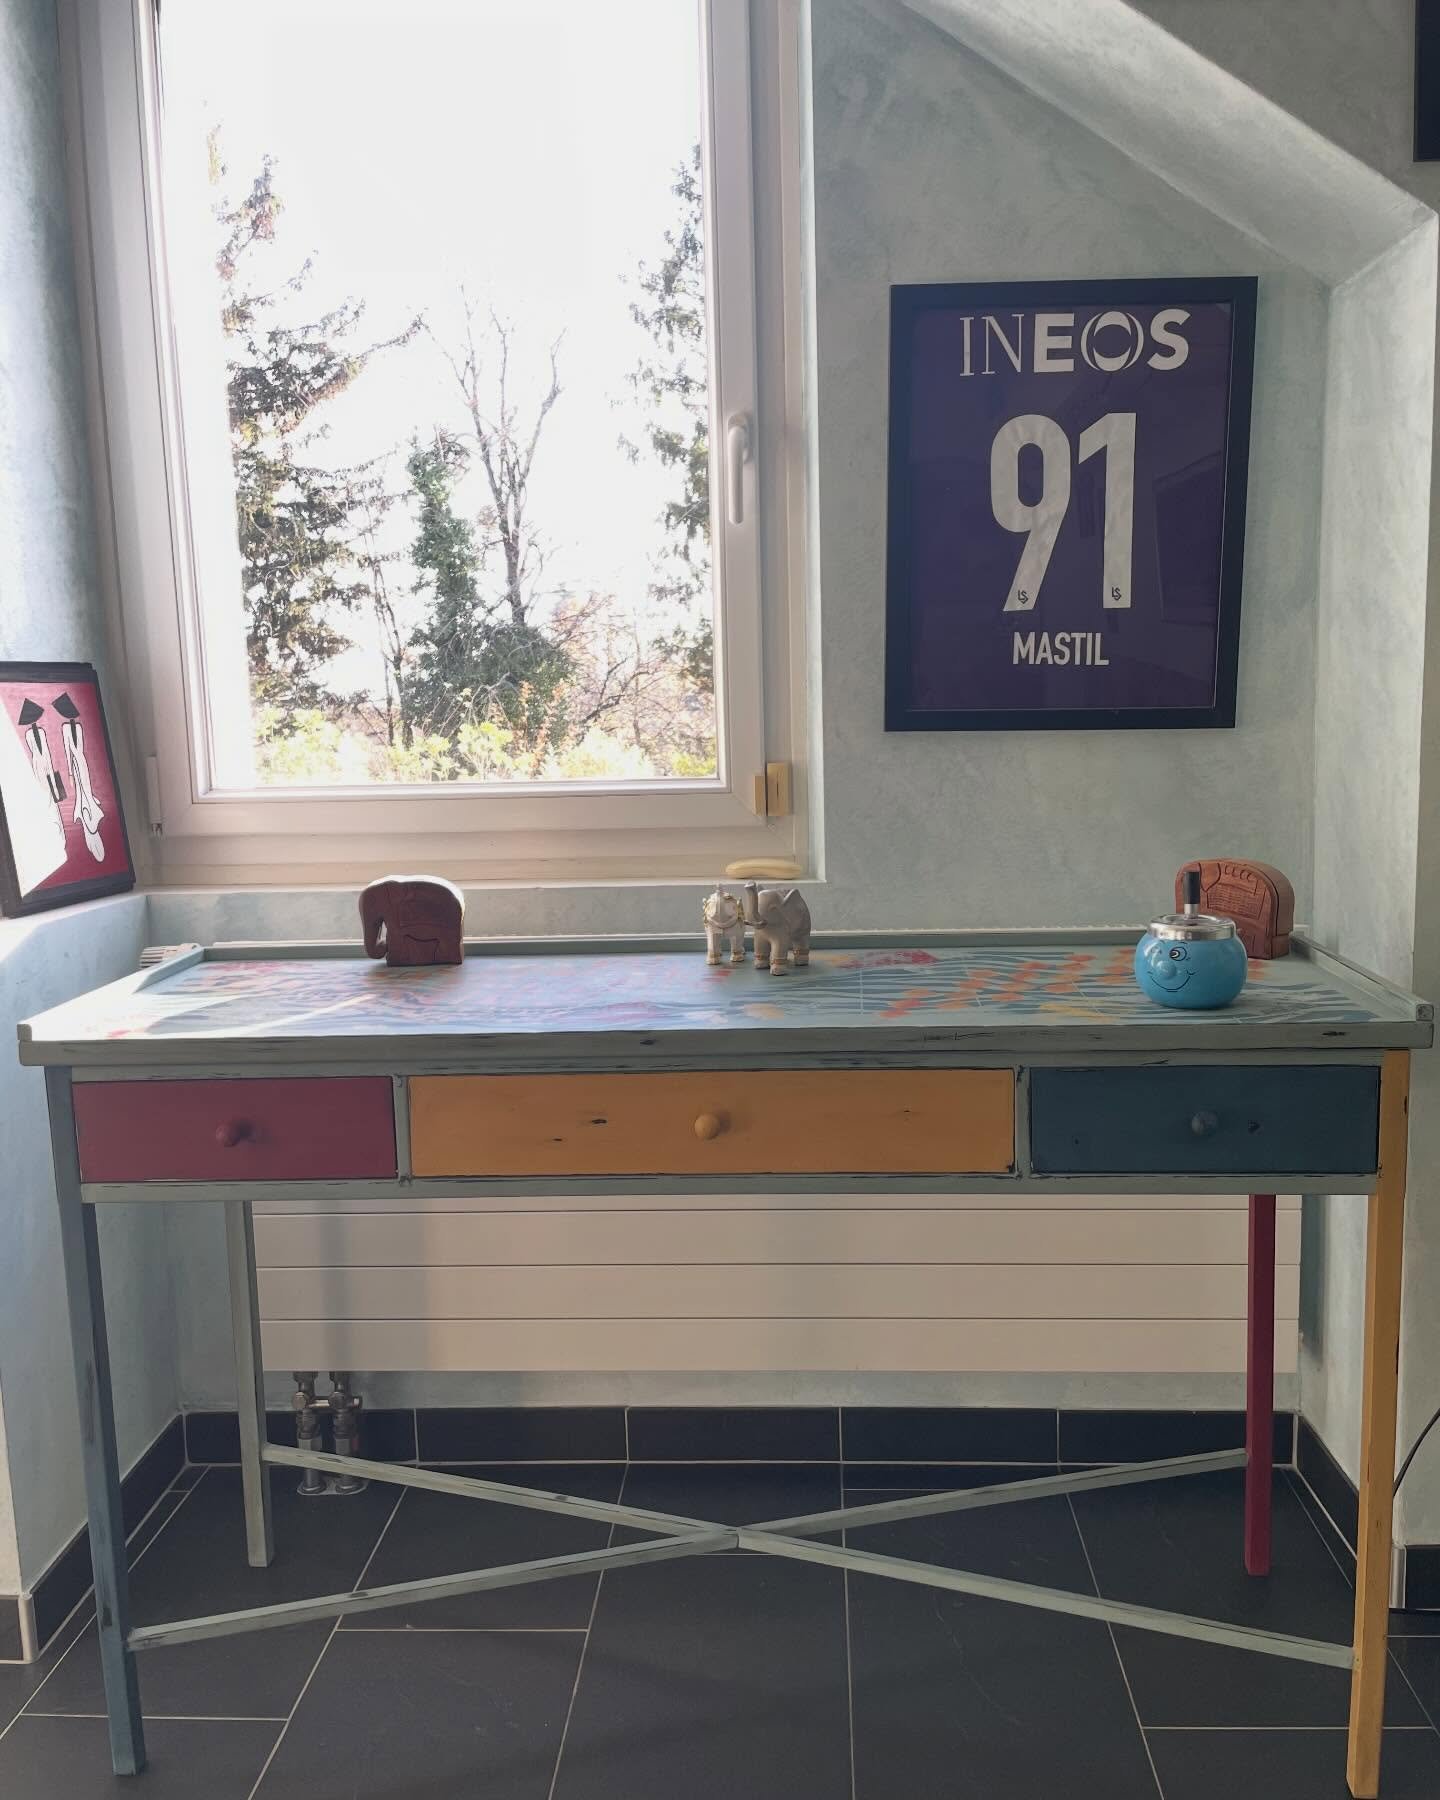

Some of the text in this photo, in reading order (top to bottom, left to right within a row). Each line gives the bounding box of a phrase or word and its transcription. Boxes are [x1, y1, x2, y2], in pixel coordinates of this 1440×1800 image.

[959, 308, 1191, 376] INEOS
[990, 412, 1137, 612] 91
[1012, 631, 1110, 666] MASTIL
